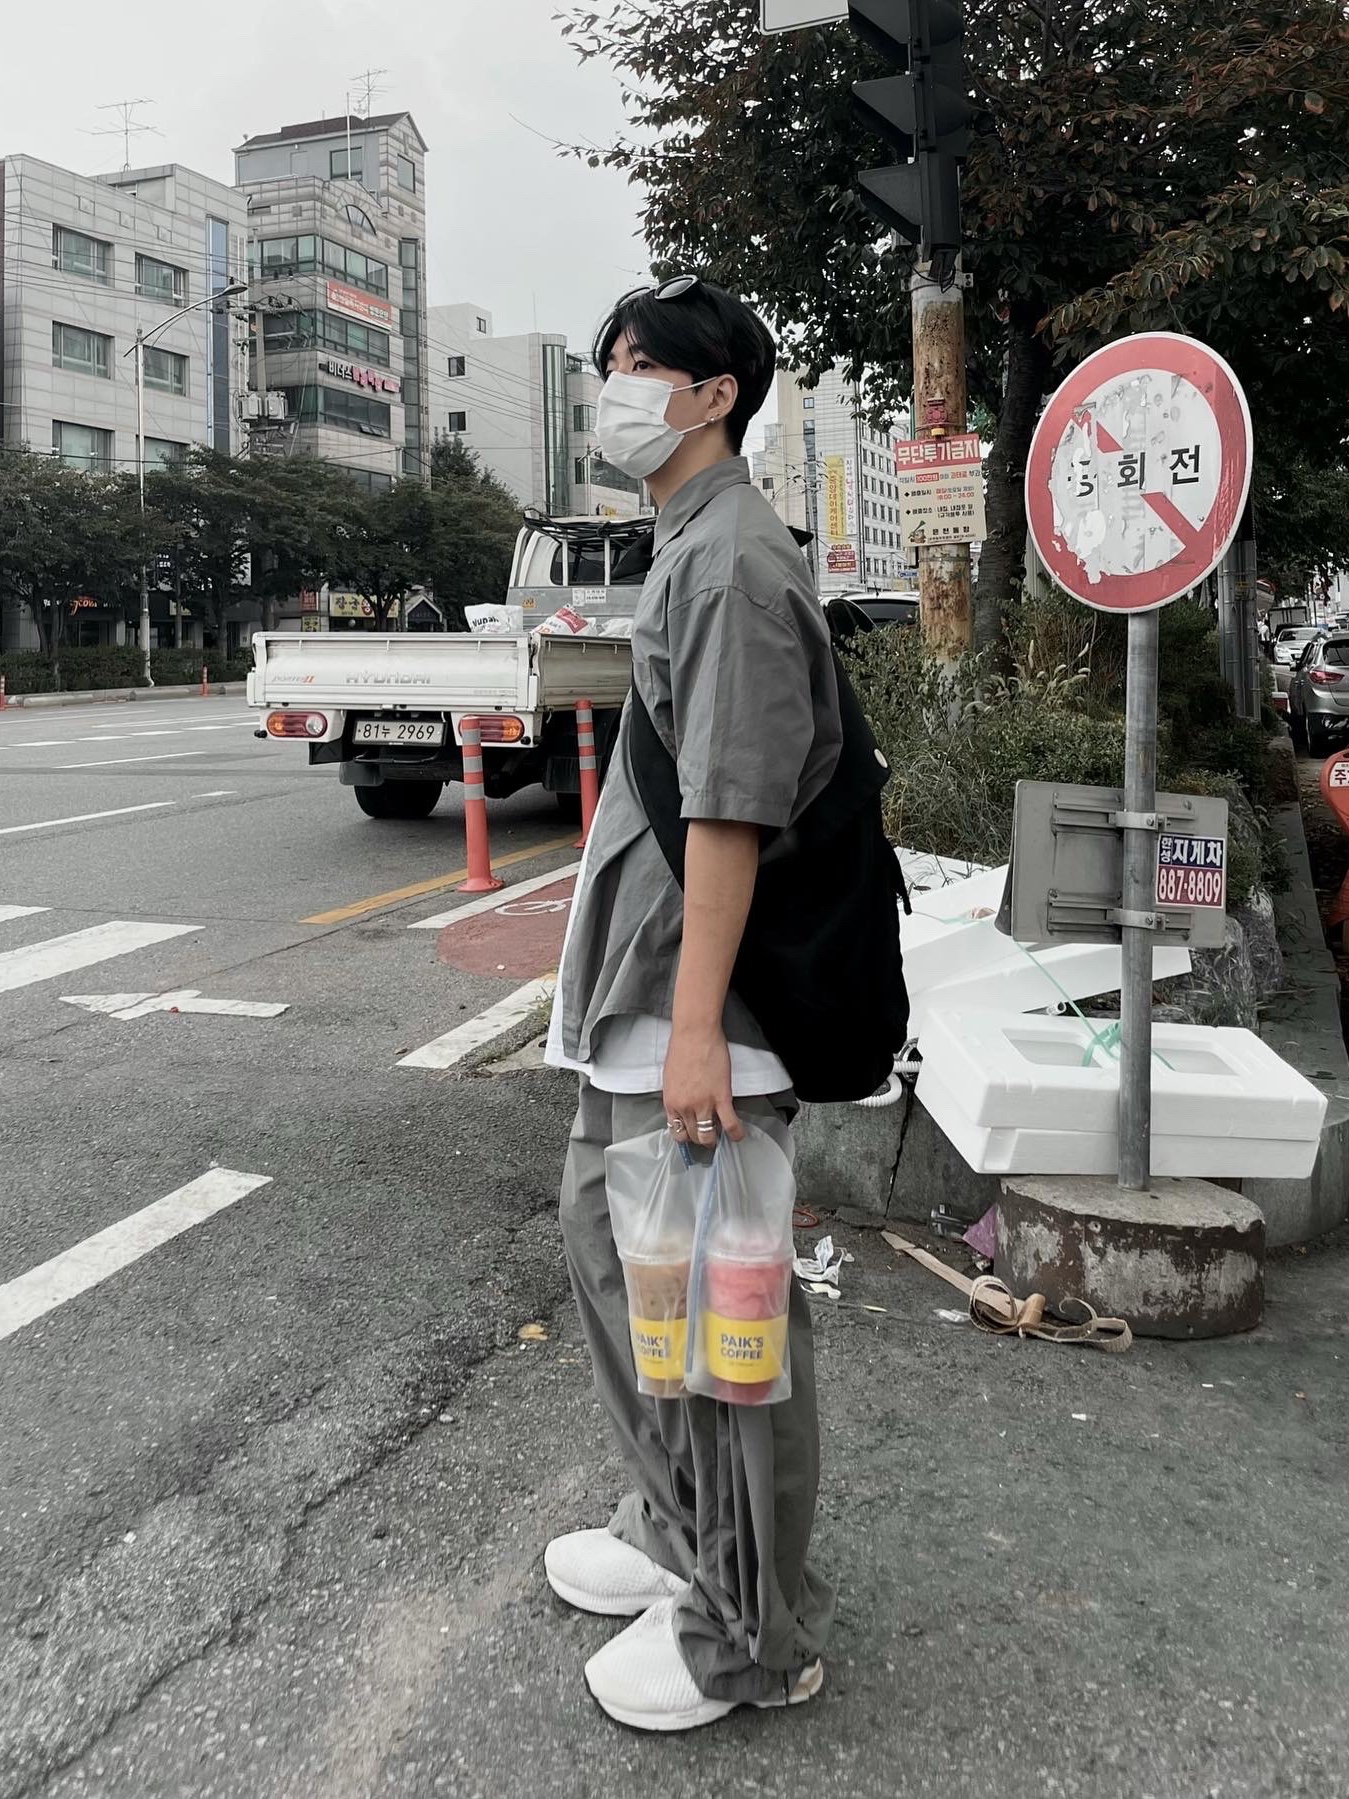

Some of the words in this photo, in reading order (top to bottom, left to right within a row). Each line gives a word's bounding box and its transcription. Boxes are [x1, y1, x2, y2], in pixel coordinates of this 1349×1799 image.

[897, 439, 979, 465] 무단투기금지
[346, 670, 431, 684] HYUNDAI
[363, 723, 391, 739] 81누
[397, 724, 435, 740] 2969
[1160, 837, 1172, 863] 한성
[1172, 839, 1222, 866] 지게차
[721, 1333, 764, 1349] PAIK'S
[721, 1347, 764, 1360] COFFEE
